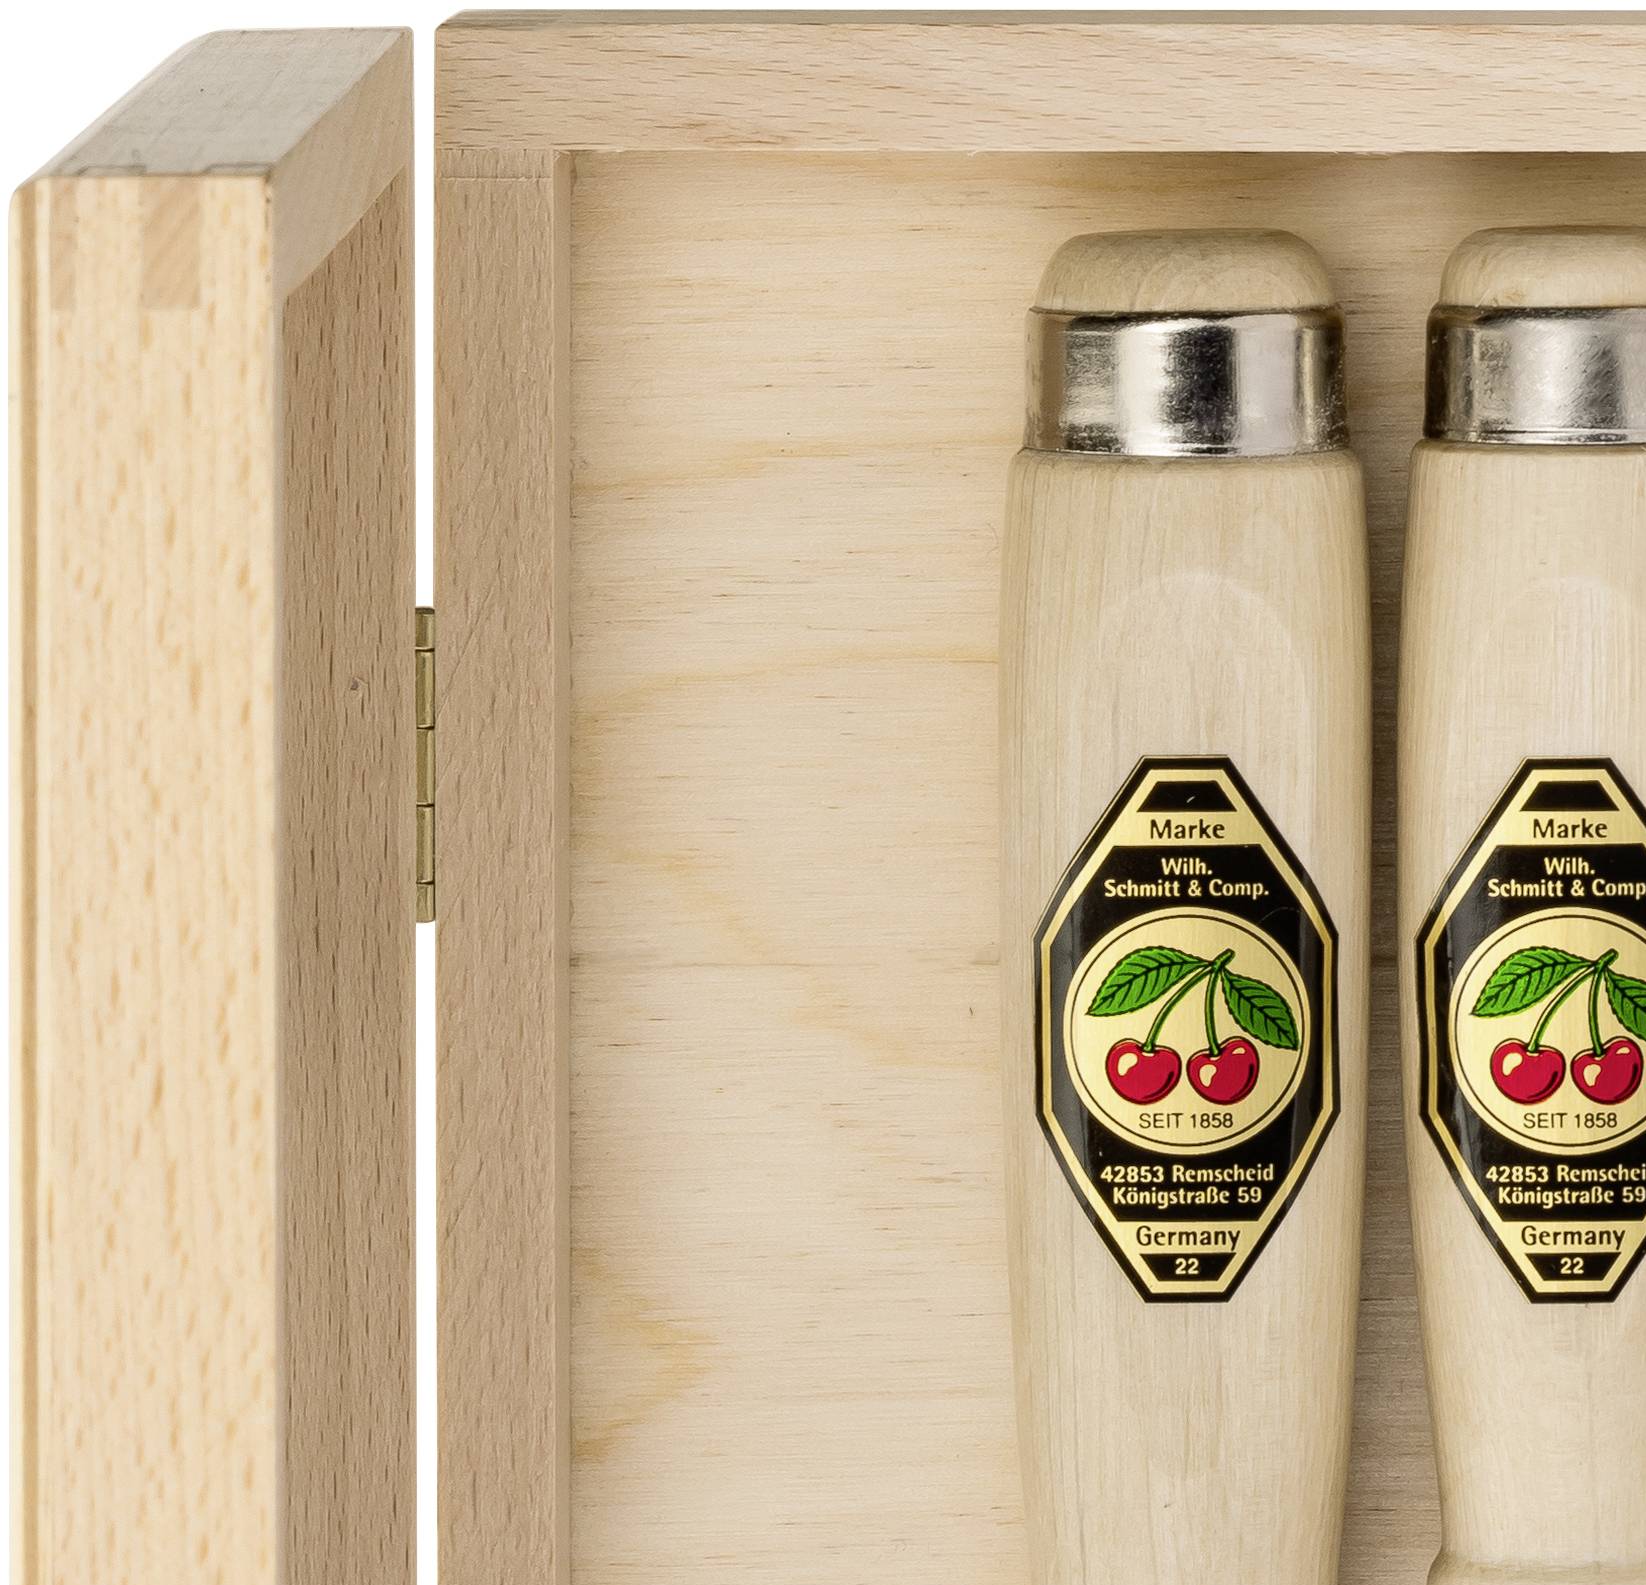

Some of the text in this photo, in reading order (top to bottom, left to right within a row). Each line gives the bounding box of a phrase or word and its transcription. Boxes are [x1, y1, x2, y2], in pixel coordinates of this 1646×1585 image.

[1150, 818, 1226, 840] Marke
[1533, 817, 1608, 839] Marke
[1161, 857, 1213, 876] Wilh.
[1543, 856, 1595, 876] Wilh.
[1103, 878, 1269, 900] Schmitt & Comp.
[1487, 878, 1564, 898] Schmitt
[1570, 879, 1585, 897] &
[1138, 1112, 1234, 1129] SEIT 1858
[1523, 1112, 1618, 1129] SEIT 1858
[1100, 1163, 1274, 1183] 42853 Remscheid
[1485, 1165, 1549, 1183] 42853
[1113, 1186, 1262, 1208] Königstraße 59
[1498, 1186, 1646, 1209] Königstraße 59
[1135, 1225, 1241, 1251] Germany
[1521, 1225, 1626, 1251] Germany
[1175, 1257, 1199, 1275] 22
[1560, 1256, 1584, 1274] 22
